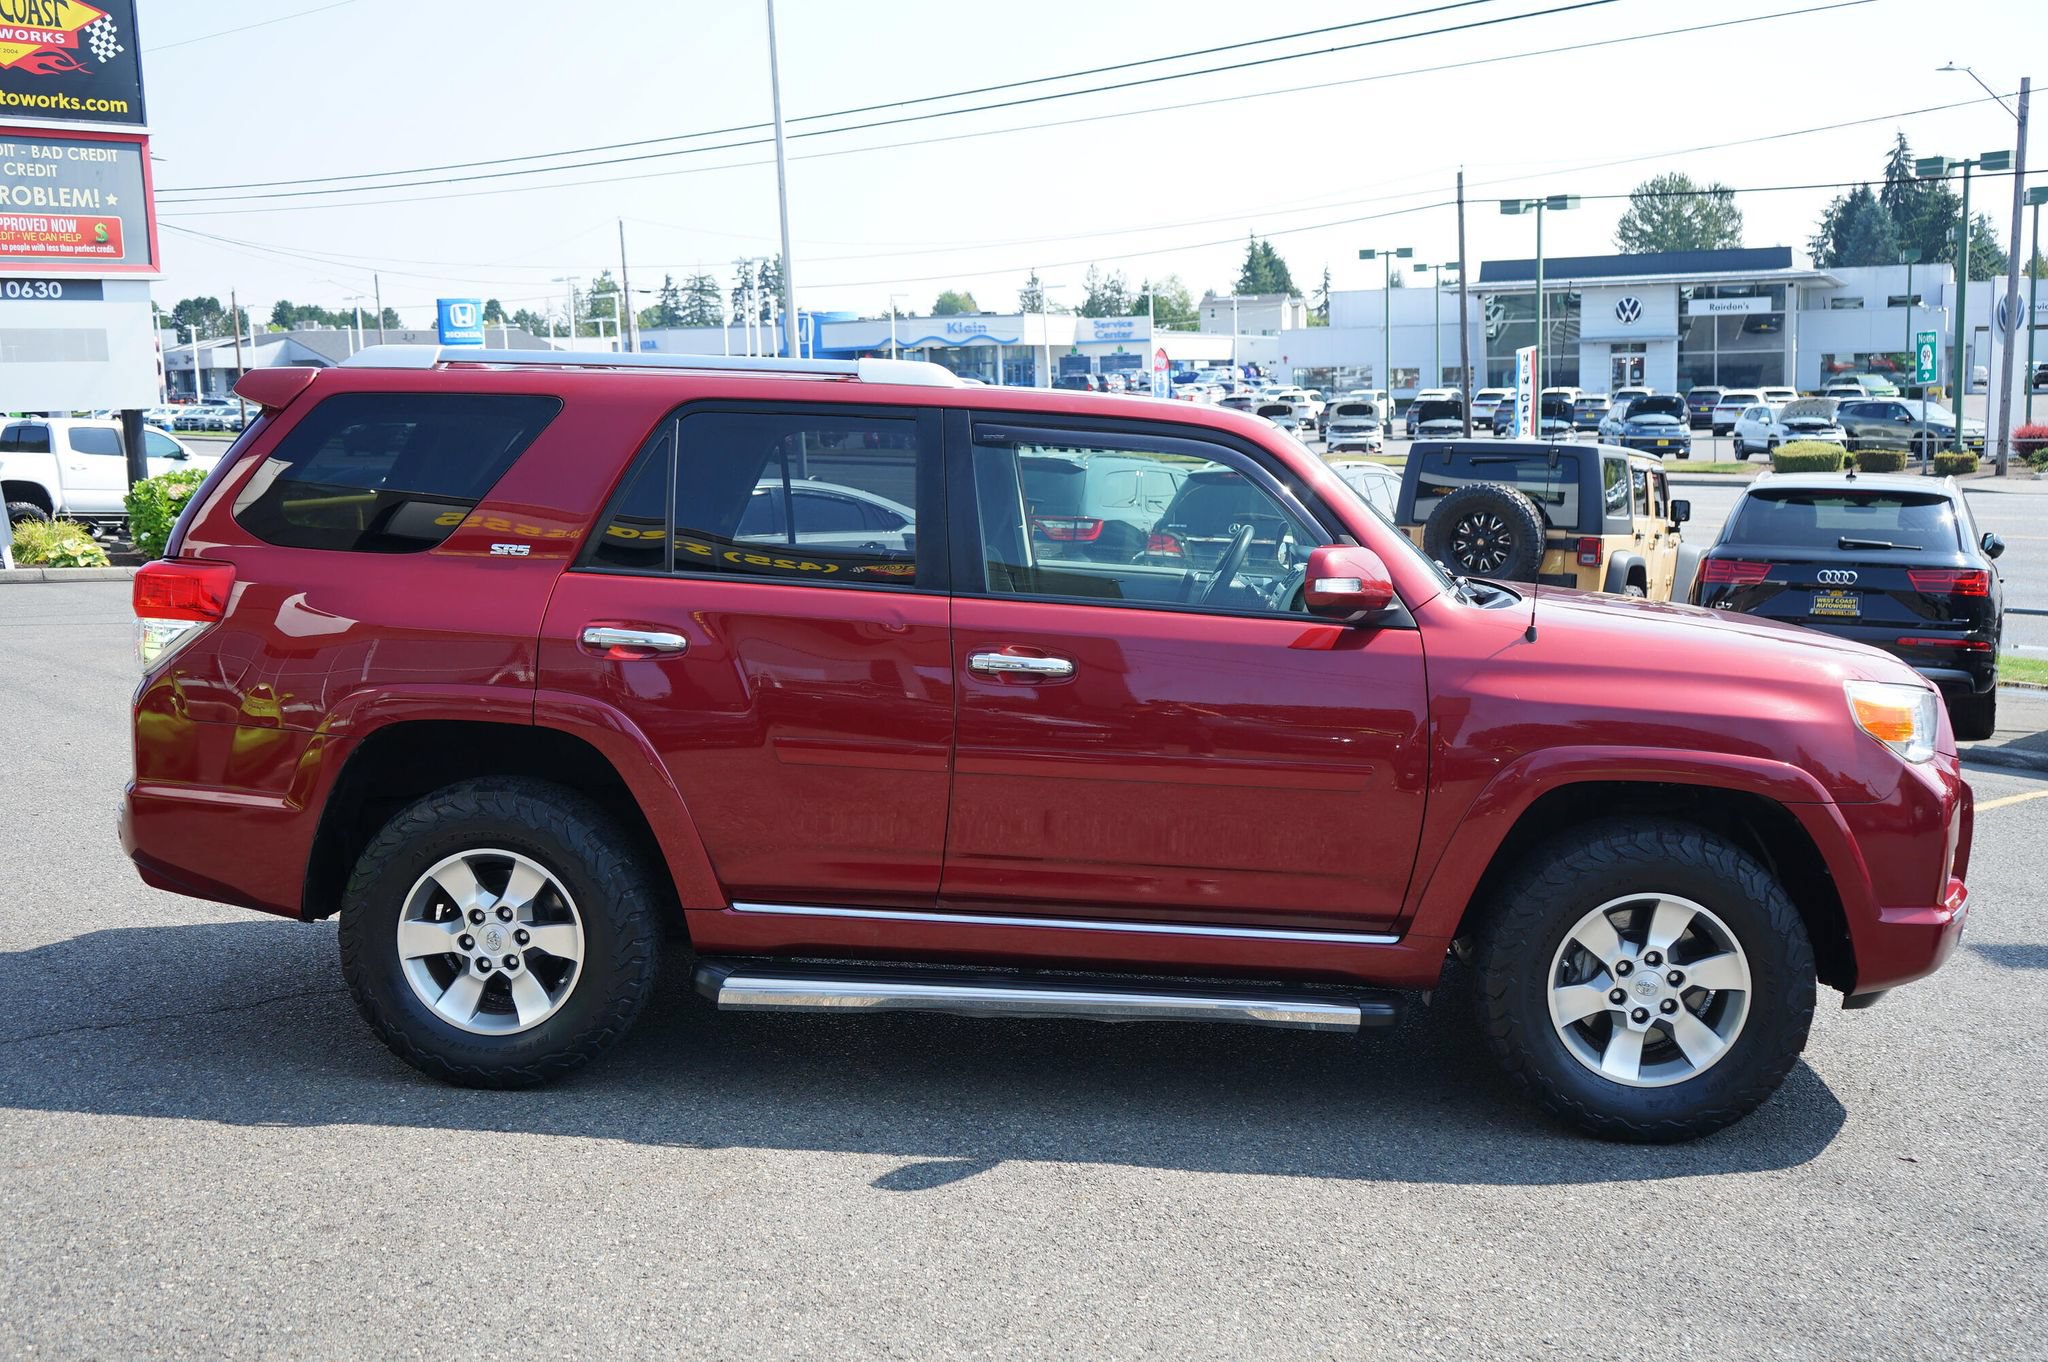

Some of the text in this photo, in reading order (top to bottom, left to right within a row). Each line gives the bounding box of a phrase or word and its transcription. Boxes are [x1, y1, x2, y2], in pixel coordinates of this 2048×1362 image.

[31, 145, 63, 159] BAD
[67, 147, 118, 162] CREDIT
[4, 162, 57, 177] CREDIT
[51, 218, 77, 233] NOW
[22, 232, 36, 241] WE
[39, 233, 57, 242] CAN
[60, 234, 82, 242] HELP
[10, 243, 30, 253] people
[31, 243, 45, 252] with
[47, 244, 59, 252] less
[75, 245, 96, 254] perfect
[947, 321, 987, 334] Klein
[1093, 319, 1134, 329] Service
[1094, 329, 1133, 339] Center
[1922, 350, 1931, 361] 99
[1521, 353, 1530, 385] NEW
[1520, 393, 1531, 435] CARS
[490, 543, 531, 556] SR5
